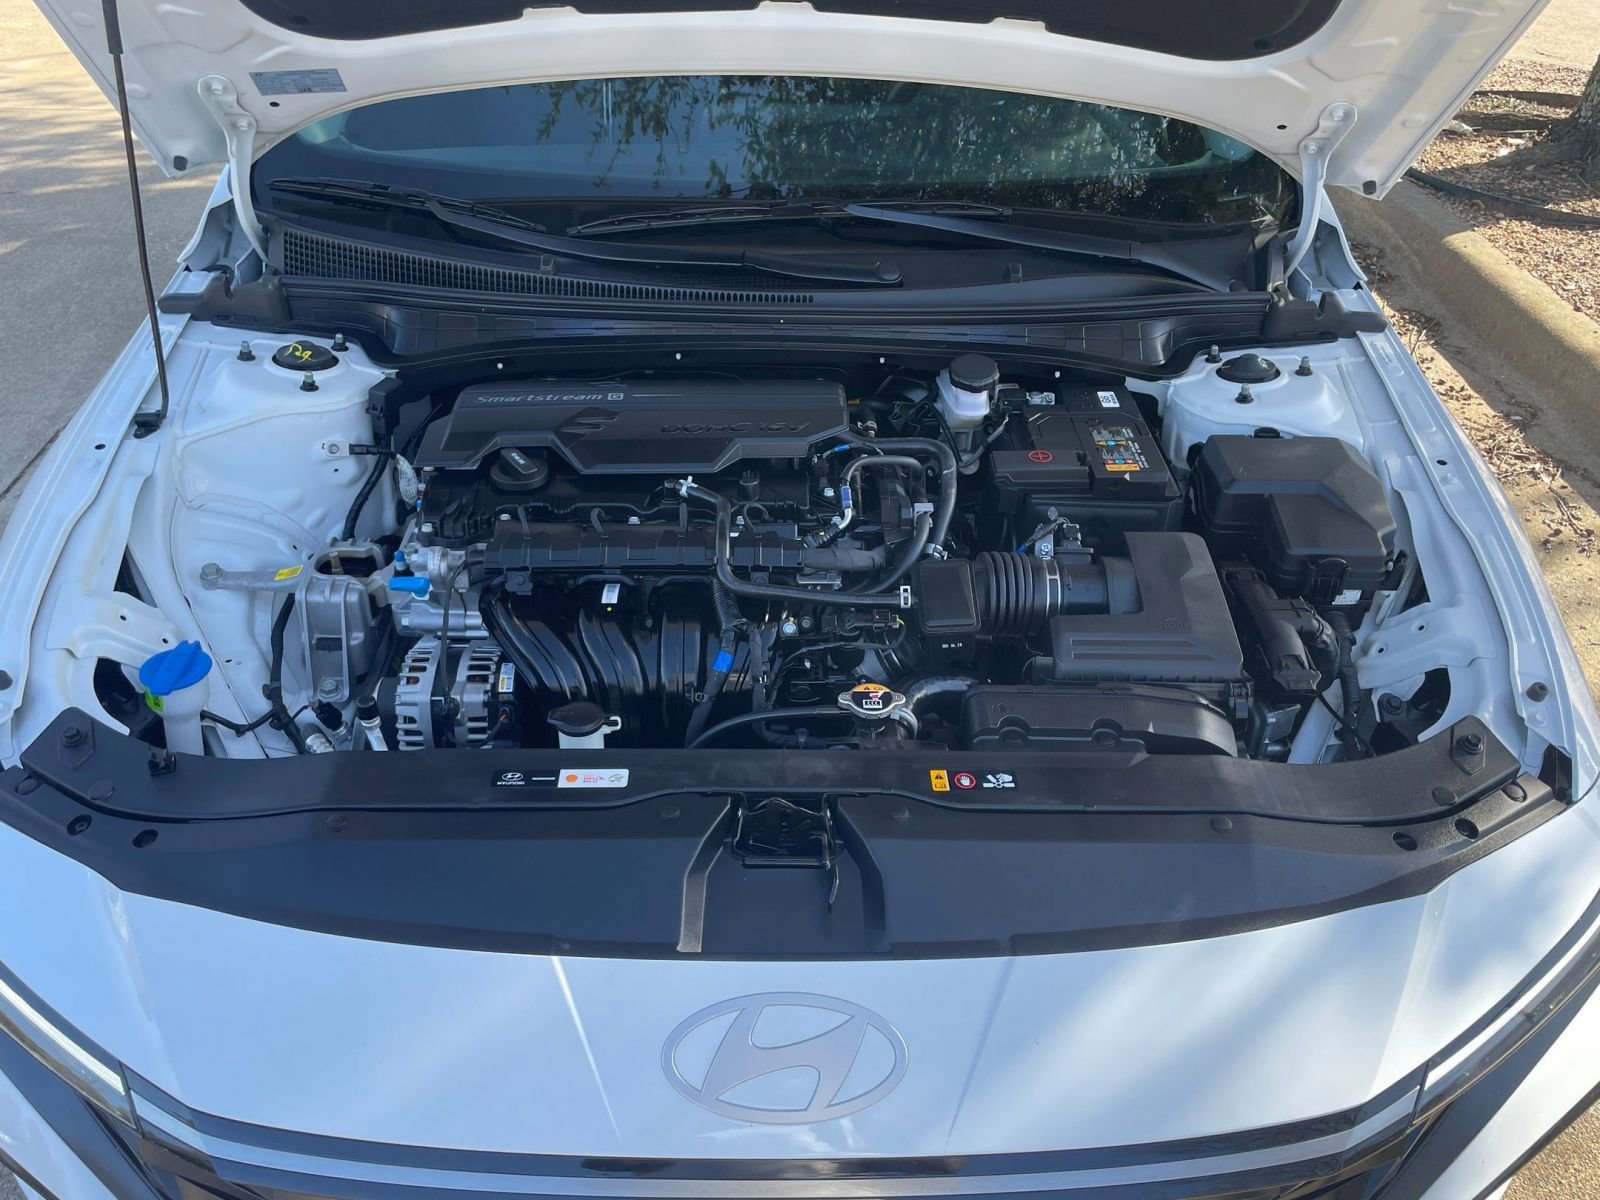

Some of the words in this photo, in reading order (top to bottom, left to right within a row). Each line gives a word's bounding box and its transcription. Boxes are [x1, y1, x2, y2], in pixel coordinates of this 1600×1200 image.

[477, 393, 604, 404] Smartstream
[660, 422, 751, 434] DOHC
[758, 421, 811, 433] 16V
